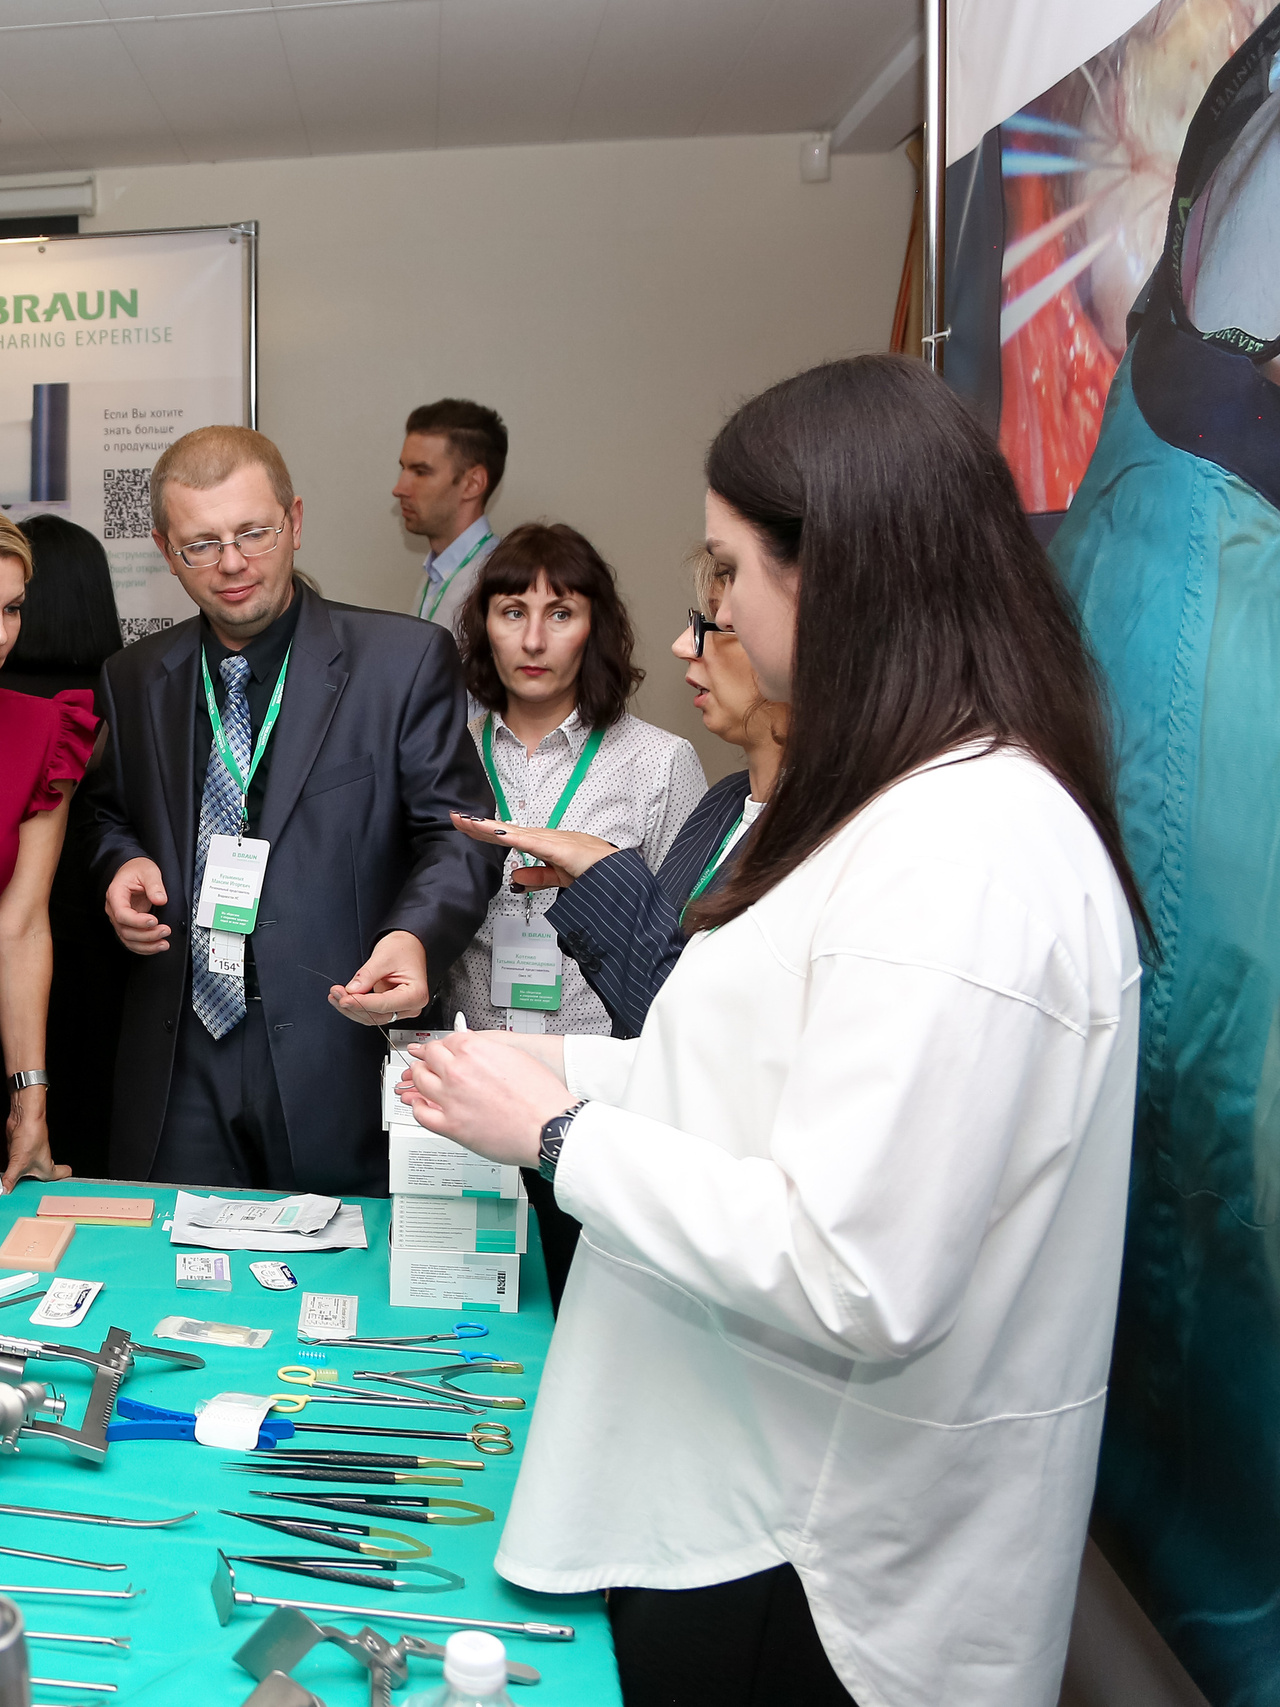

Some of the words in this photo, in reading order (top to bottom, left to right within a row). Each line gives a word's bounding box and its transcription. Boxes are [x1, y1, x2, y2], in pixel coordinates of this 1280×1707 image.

[75, 327, 173, 346] EXPERTISE
[1216, 328, 1264, 352] UNIVET
[104, 409, 128, 419] Если
[132, 408, 146, 419] Вы
[150, 409, 183, 418] хотите
[104, 427, 131, 435] знать
[135, 424, 174, 434] больше
[104, 443, 110, 451] о
[218, 960, 236, 972] 154
